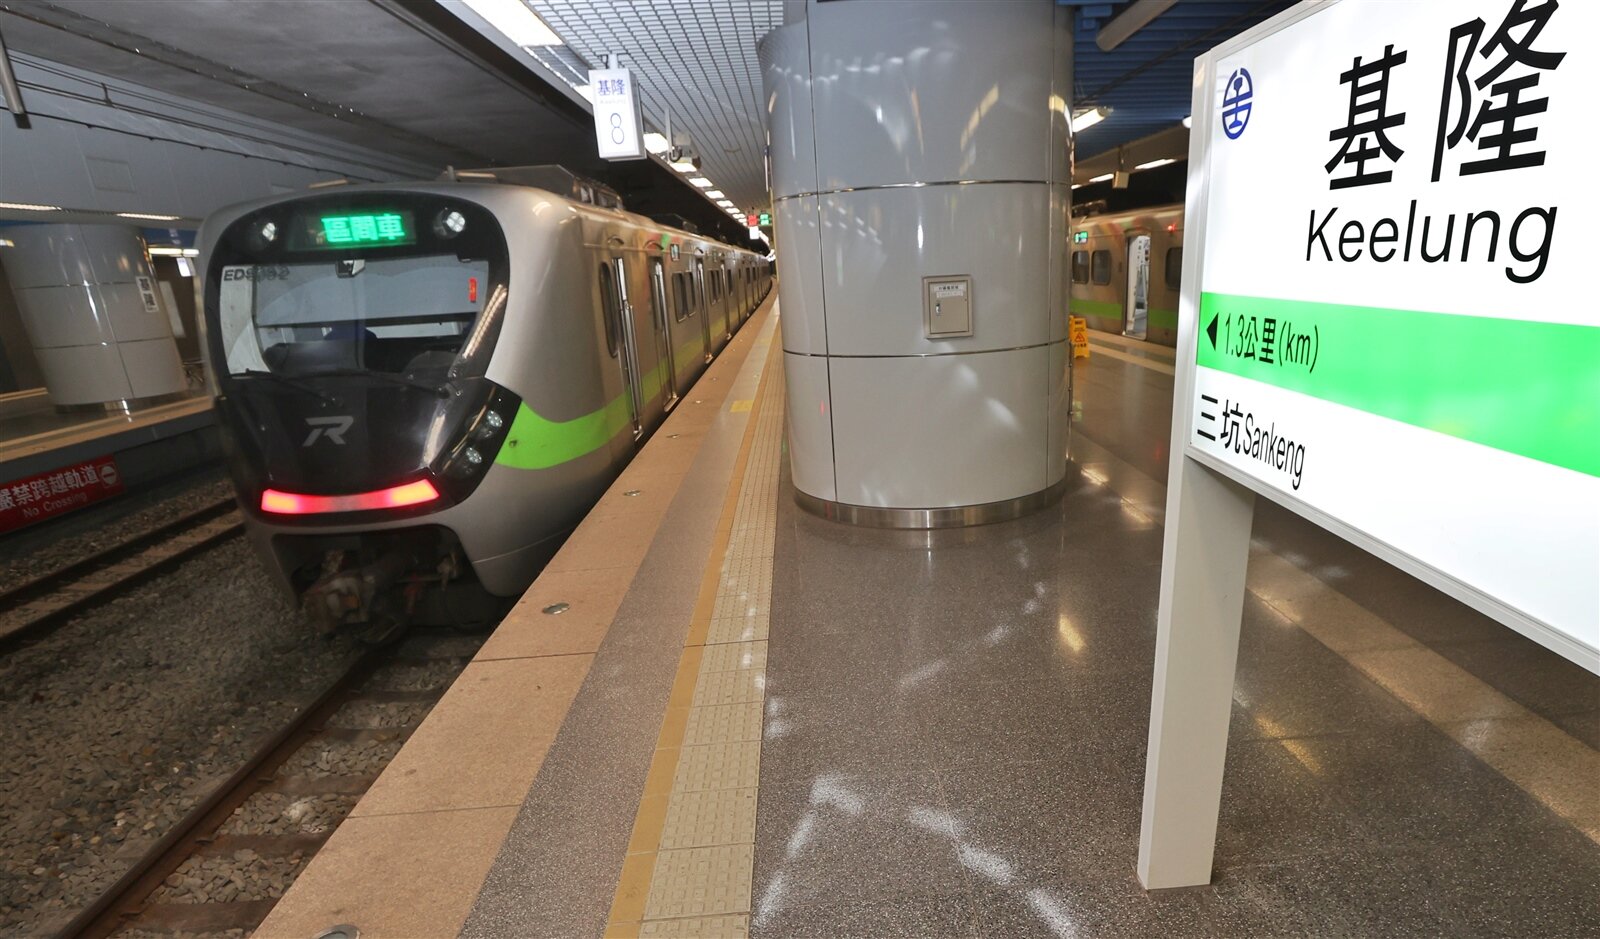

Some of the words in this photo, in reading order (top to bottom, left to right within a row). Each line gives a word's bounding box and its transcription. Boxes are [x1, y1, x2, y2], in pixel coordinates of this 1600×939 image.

[598, 79, 626, 96] 基隆
[1324, 0, 1568, 191] 基隆
[610, 112, 625, 145] 8
[321, 213, 405, 242] 區間車
[1305, 199, 1558, 284] Keelung
[1243, 412, 1306, 491] Sankeng
[23, 506, 40, 519] No
[43, 491, 88, 512] Crossing
